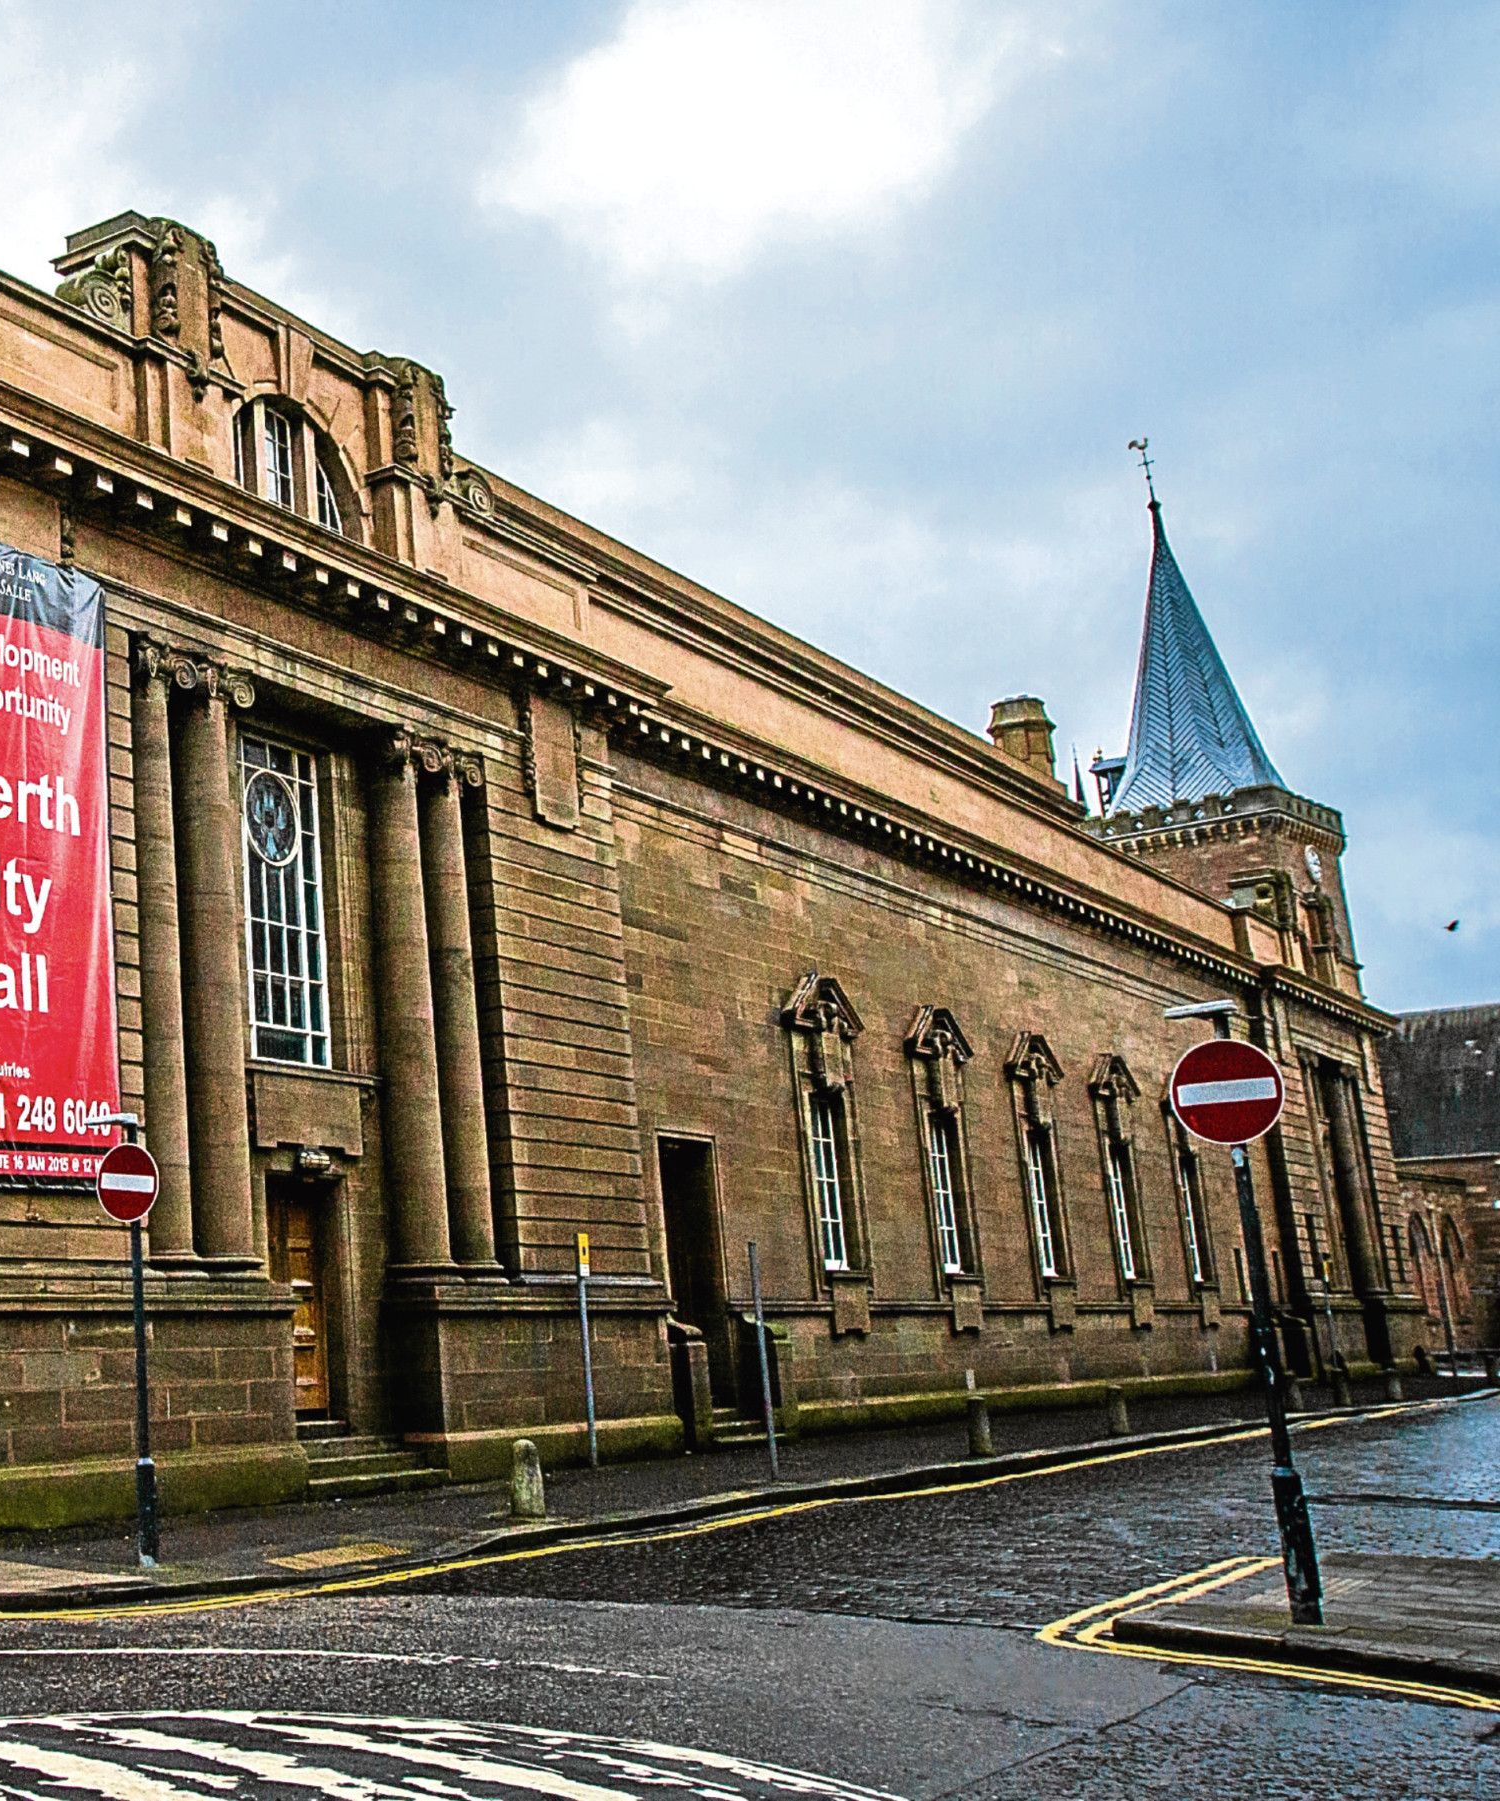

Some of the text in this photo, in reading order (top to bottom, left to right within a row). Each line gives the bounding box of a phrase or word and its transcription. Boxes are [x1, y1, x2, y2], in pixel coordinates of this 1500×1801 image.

[17, 1094, 56, 1133] 248
[13, 1154, 23, 1170] 16
[26, 1156, 45, 1171] JAN
[48, 1156, 69, 1172] 2015
[82, 1158, 92, 1173] 12
